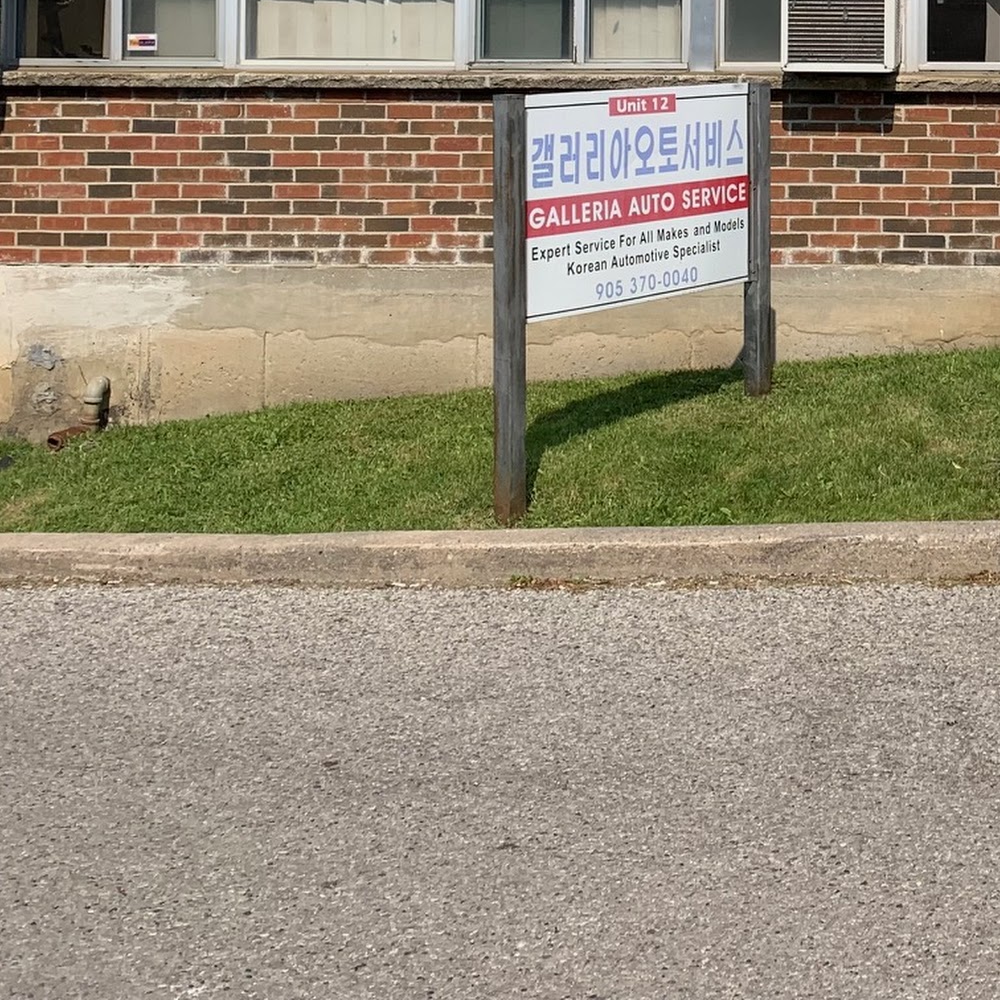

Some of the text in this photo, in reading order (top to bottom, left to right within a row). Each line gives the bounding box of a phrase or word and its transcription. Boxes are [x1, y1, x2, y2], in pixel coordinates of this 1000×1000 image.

[616, 97, 669, 113] Unit 12
[531, 119, 744, 189] 갤러리아오토서비스
[529, 182, 746, 229] GALLERIA AUTO SERVICE
[531, 217, 745, 262] Expert Service For All Makes and Models
[567, 240, 721, 276] Korean Automotive Specialist
[595, 266, 699, 300] 905 370-0040
